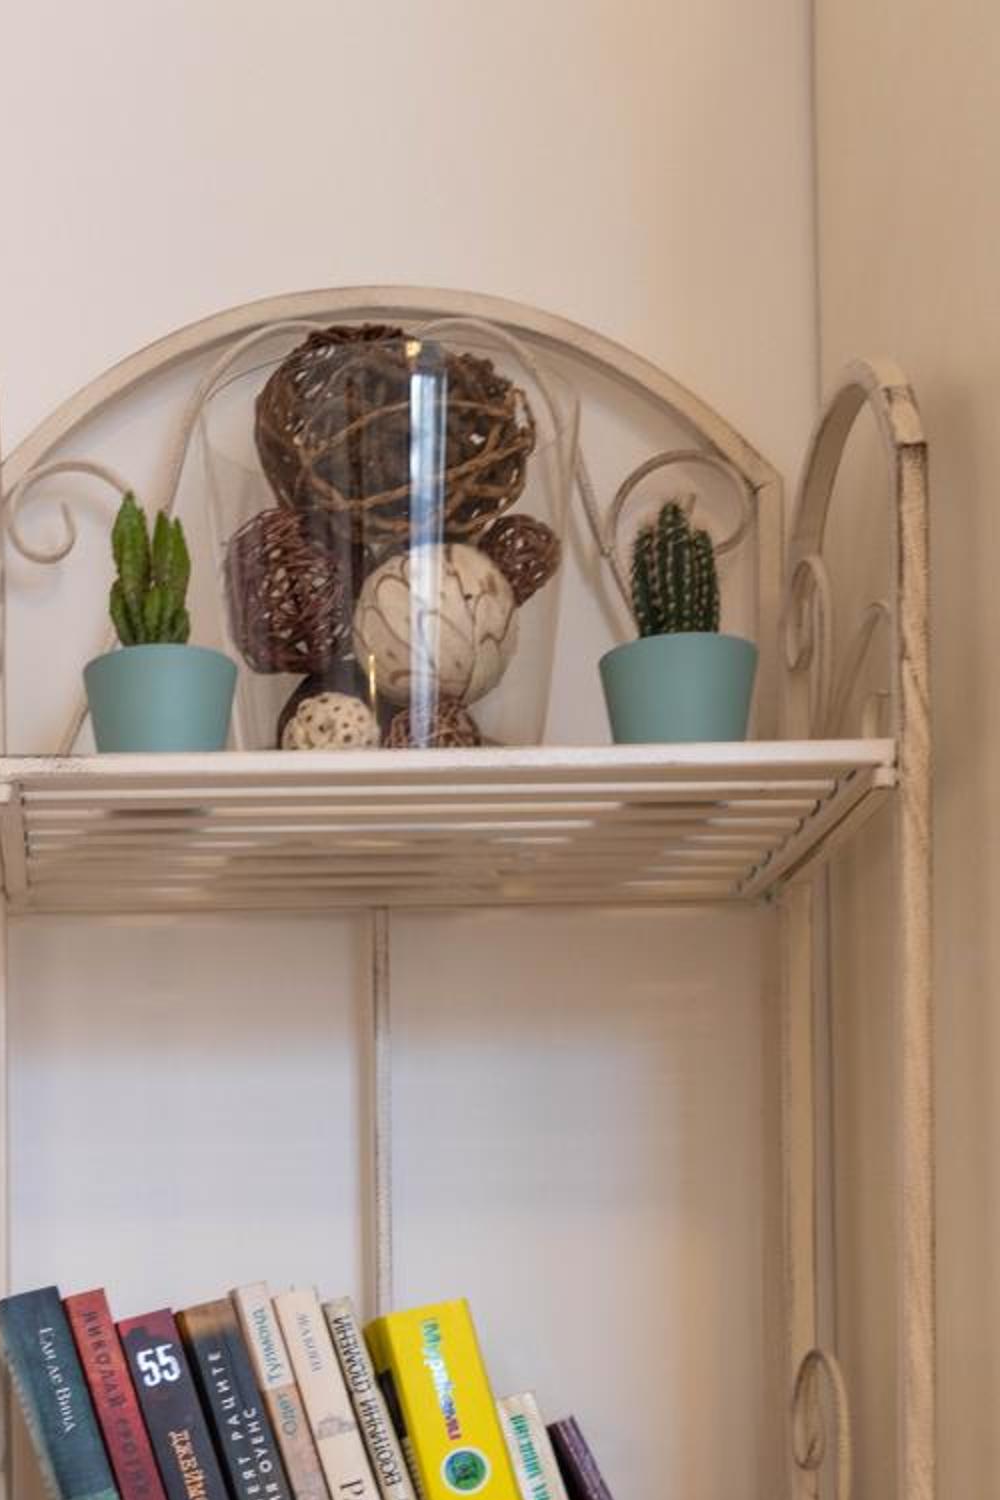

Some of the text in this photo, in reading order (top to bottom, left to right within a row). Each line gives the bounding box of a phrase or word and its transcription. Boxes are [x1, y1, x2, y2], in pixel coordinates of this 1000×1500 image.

[82, 1310, 126, 1408] НИКОЛАЙ
[136, 1345, 180, 1386] 55
[332, 1313, 373, 1394] СПОМЕНИ
[206, 1349, 247, 1441] РАЦИТЕ
[242, 1405, 274, 1473] ОУЕНС
